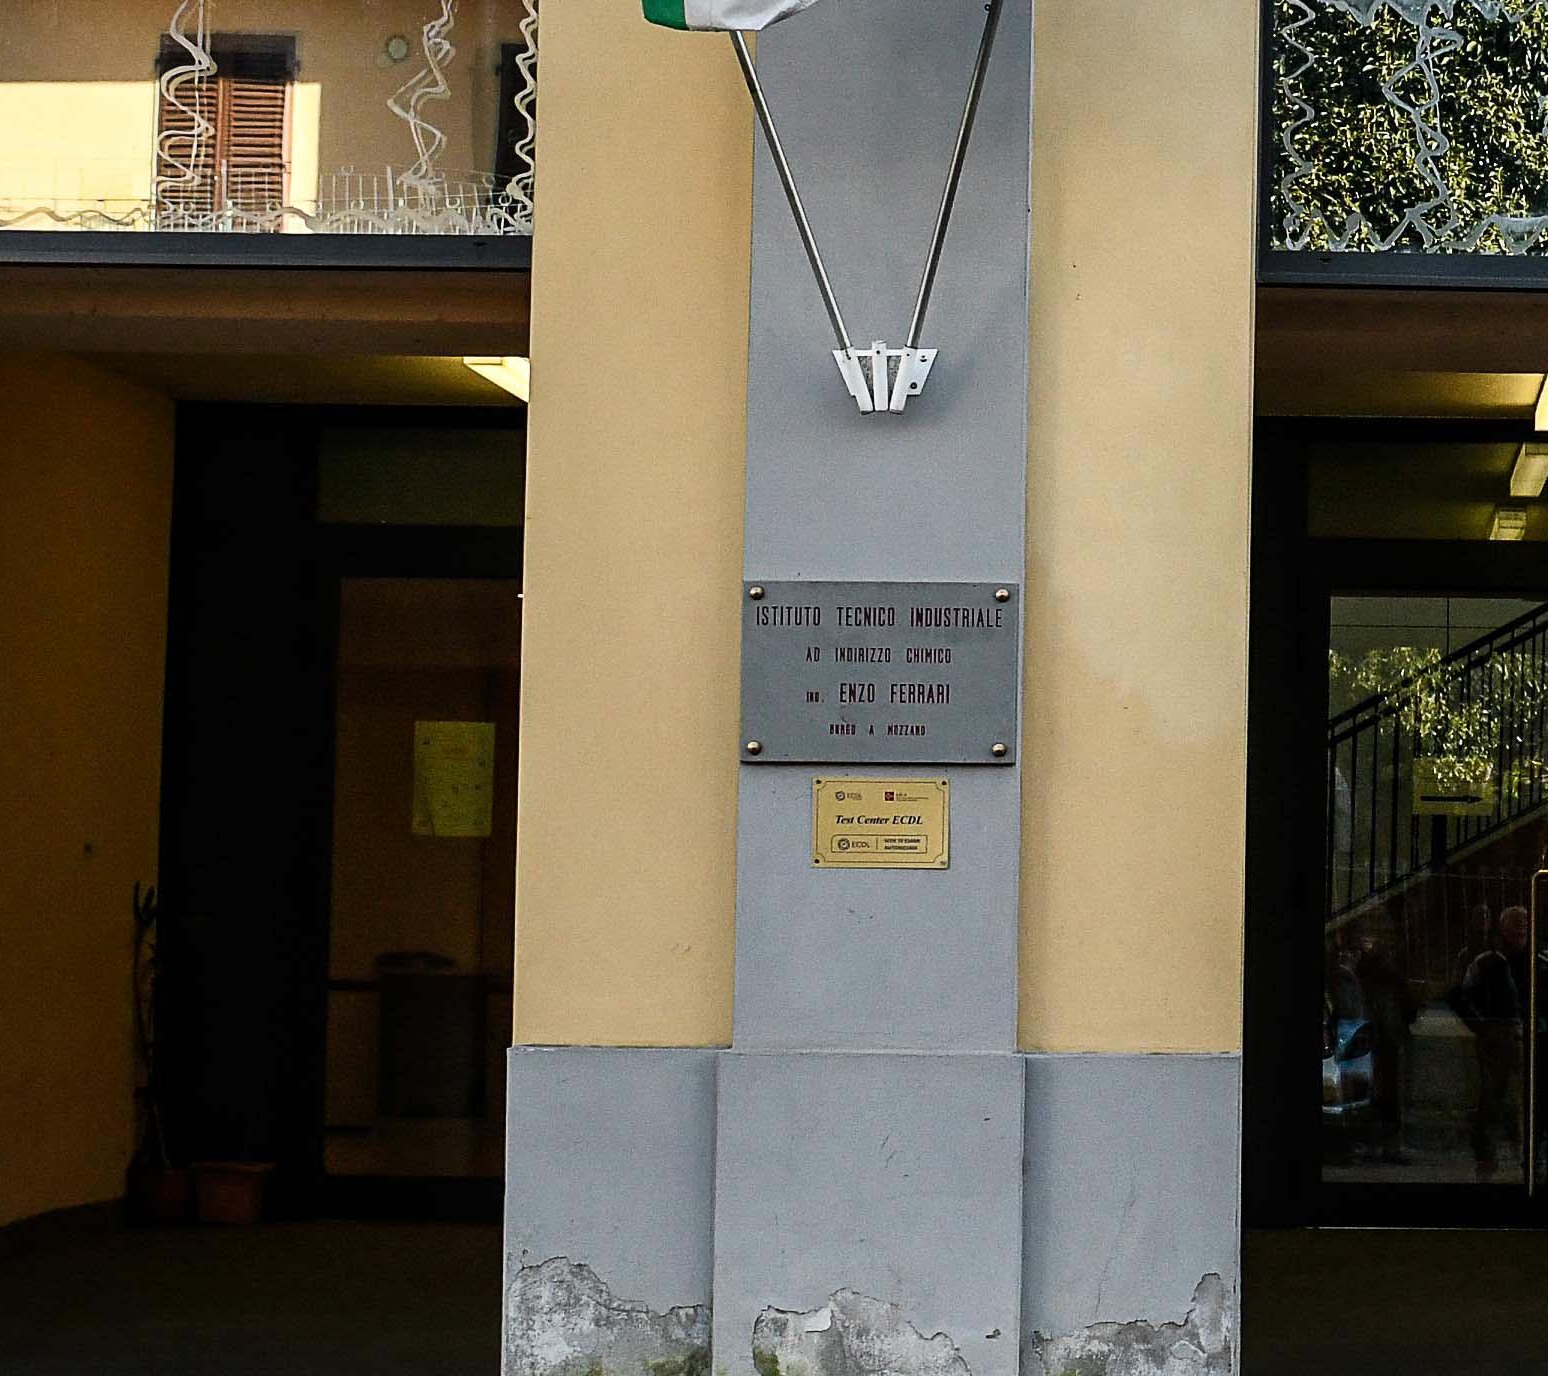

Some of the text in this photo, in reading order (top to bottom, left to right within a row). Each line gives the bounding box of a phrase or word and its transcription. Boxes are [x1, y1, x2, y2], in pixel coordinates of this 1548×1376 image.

[756, 605, 1003, 628] ISTITUTO TECNICO INDUSTRIALE
[806, 646, 952, 664] AD INDIRIZZO CHIMICO
[839, 682, 875, 703] ENZO
[890, 683, 950, 704] FERRARI
[836, 814, 924, 825] Test Center ECDL
